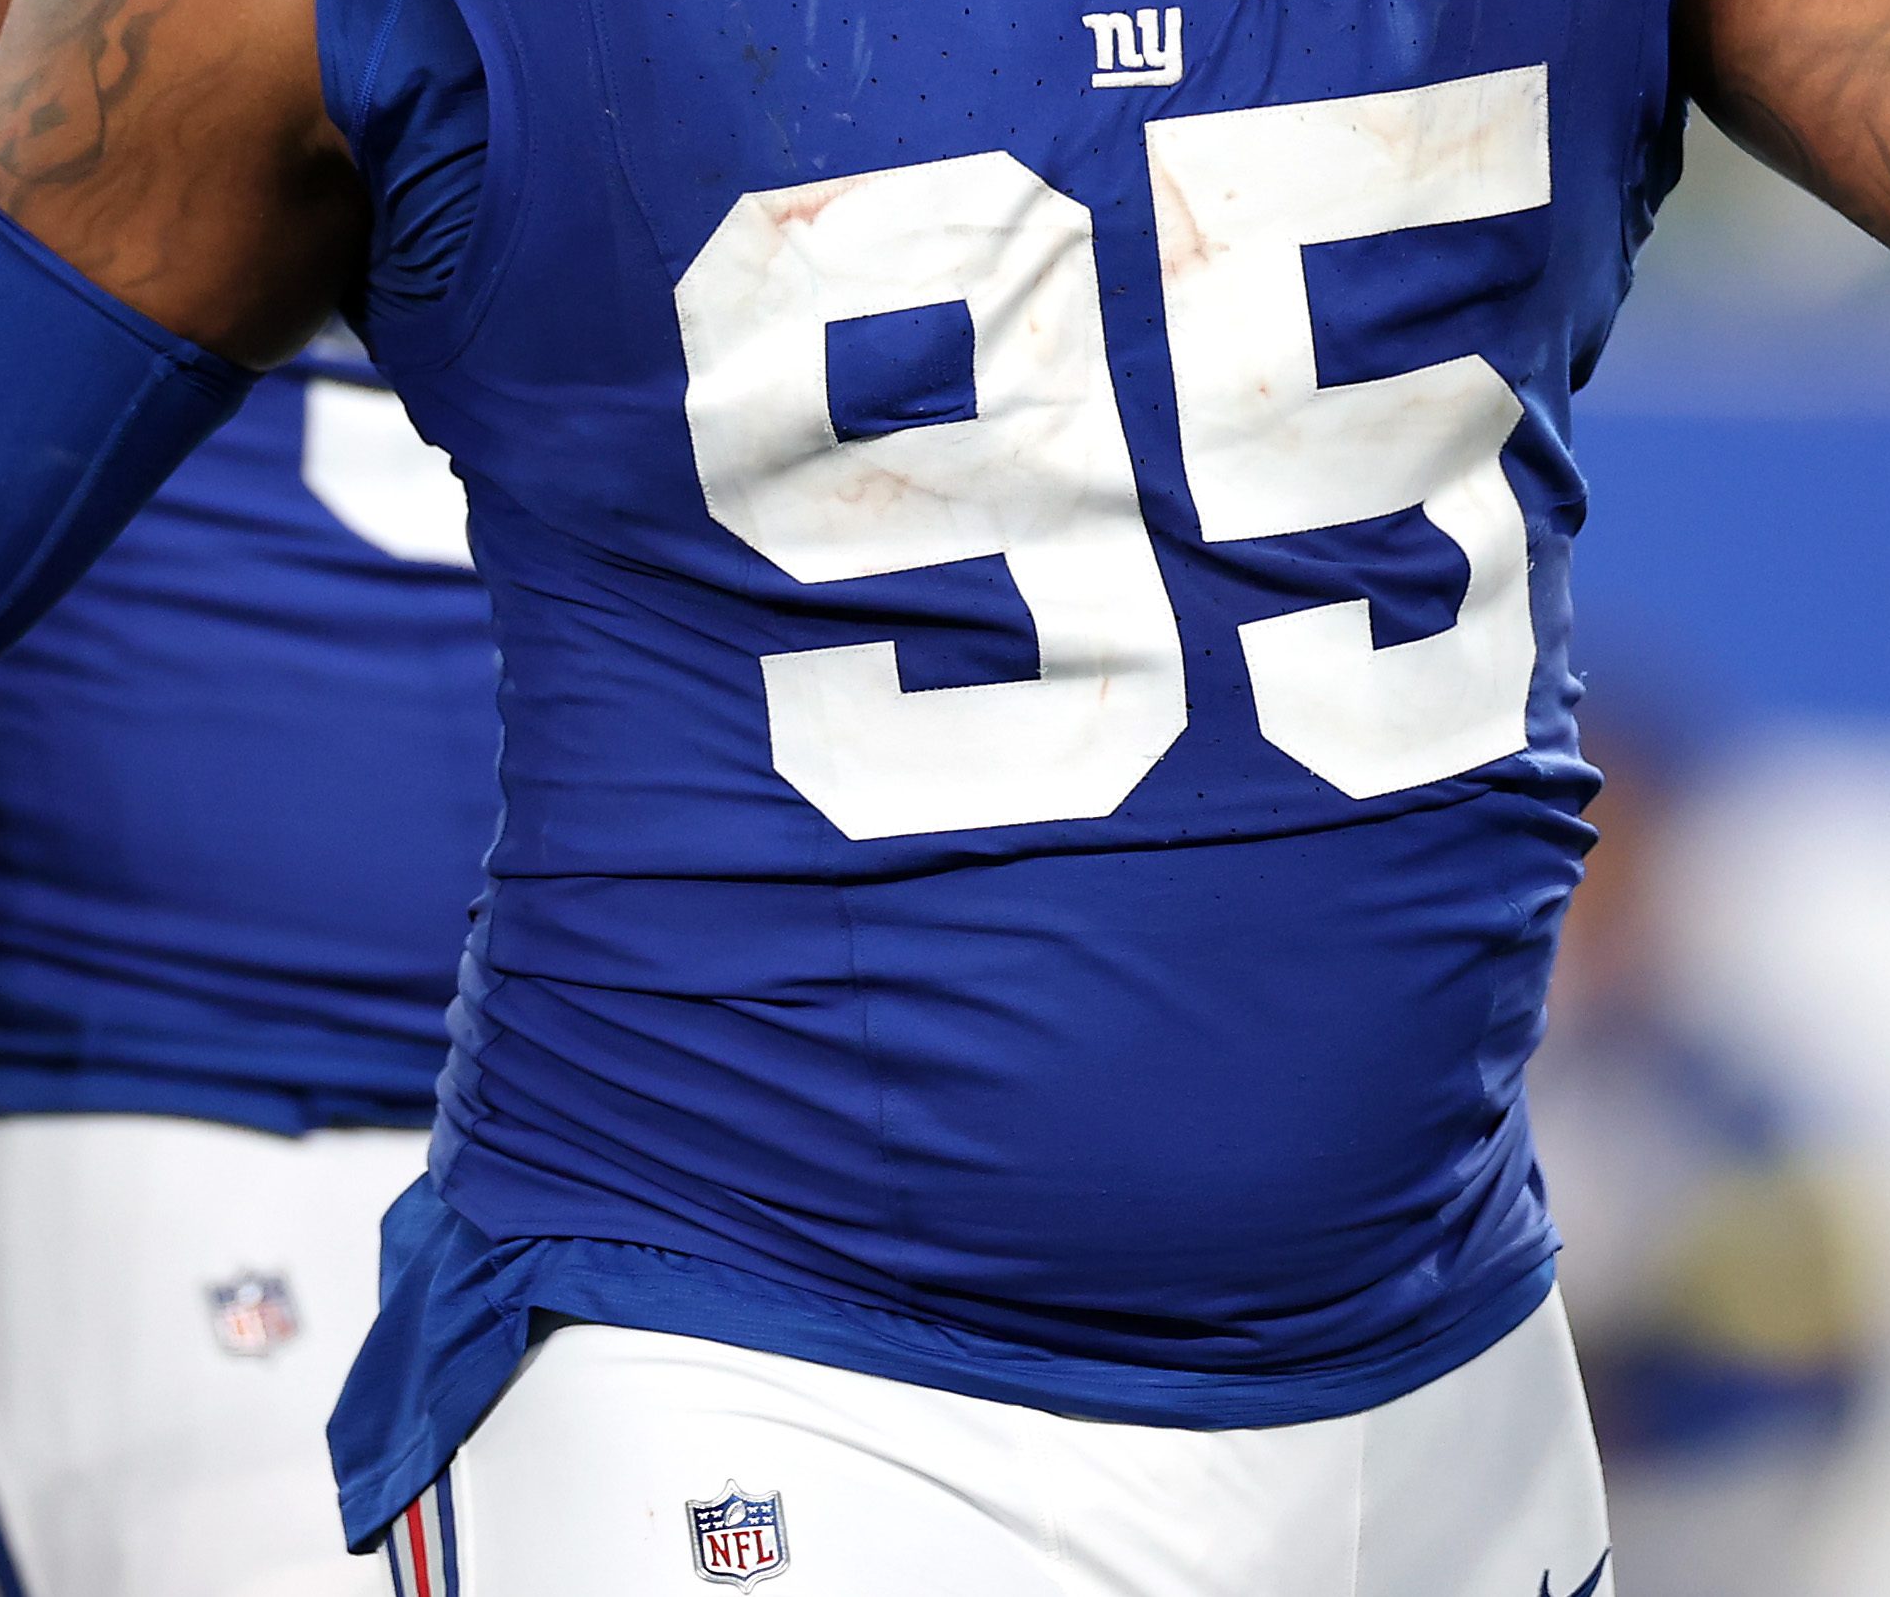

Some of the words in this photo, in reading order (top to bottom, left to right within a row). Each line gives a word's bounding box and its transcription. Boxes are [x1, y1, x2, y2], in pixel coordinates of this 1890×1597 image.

[1081, 6, 1183, 89] ny
[673, 62, 1552, 842] 95
[706, 1529, 775, 1570] NFL
